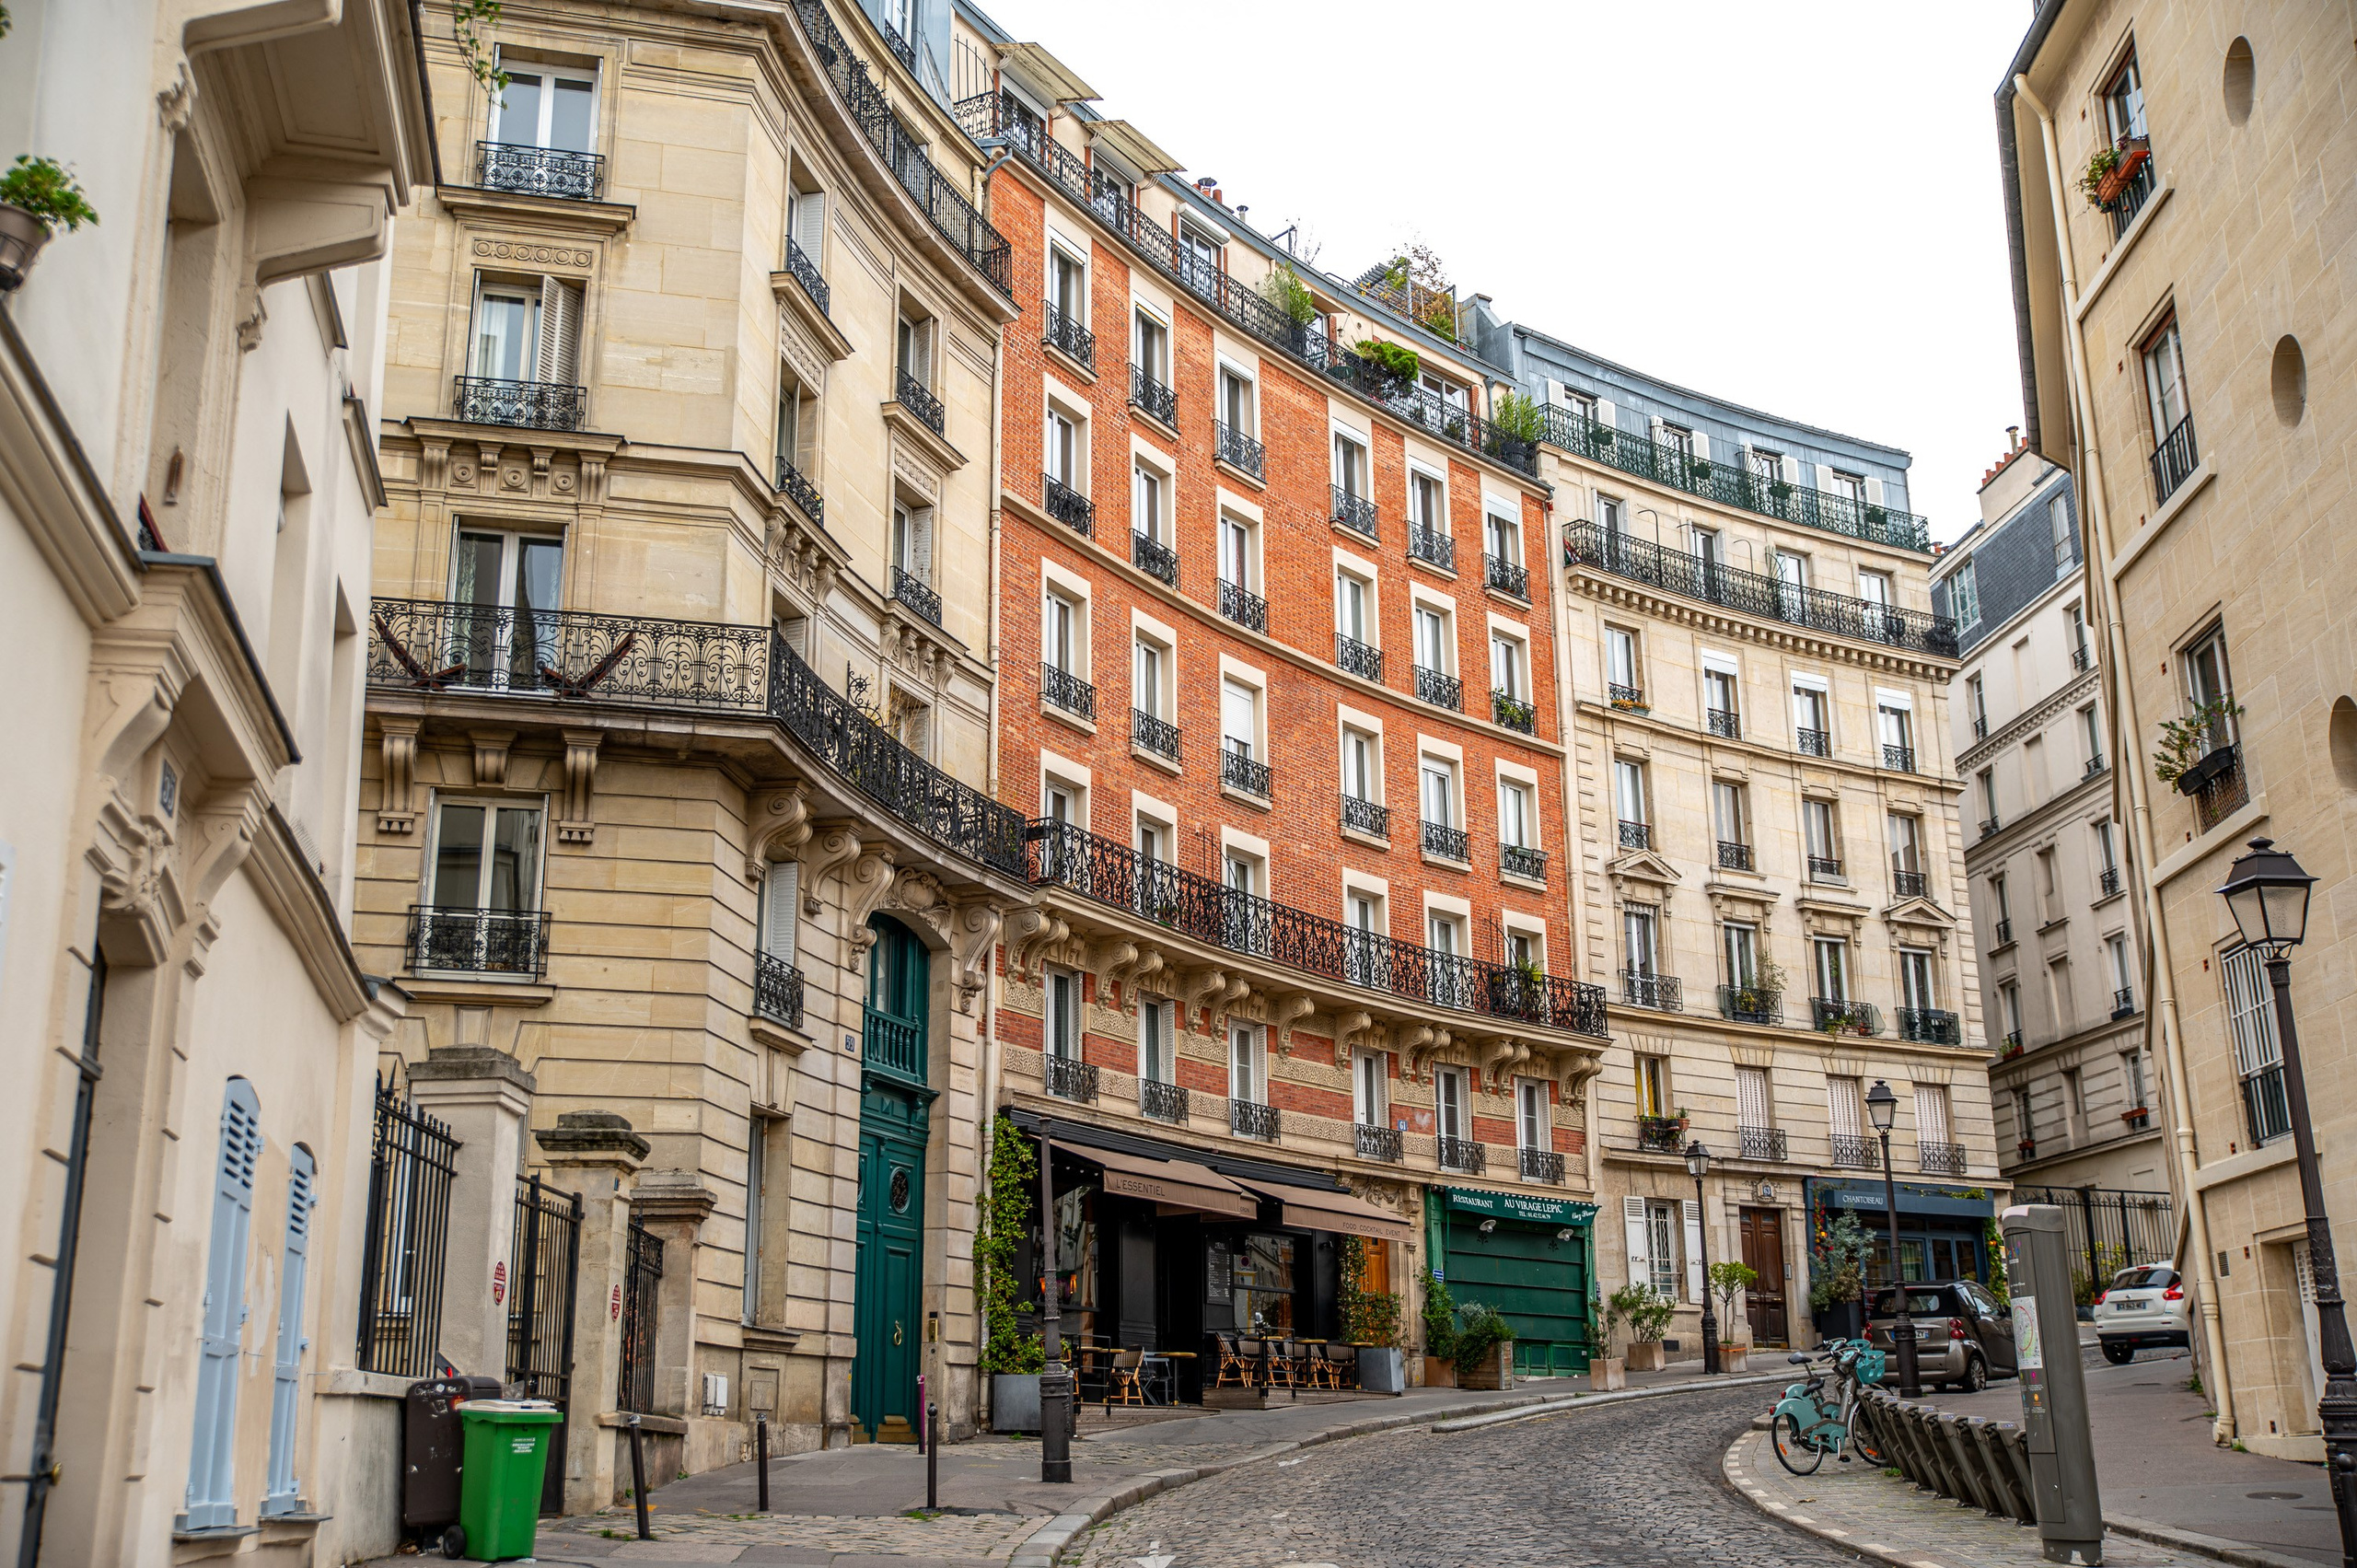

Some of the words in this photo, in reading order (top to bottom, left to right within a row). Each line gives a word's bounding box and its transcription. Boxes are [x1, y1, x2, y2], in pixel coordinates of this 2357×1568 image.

[846, 1035, 854, 1051] 59
[1399, 1121, 1406, 1131] 61
[1116, 1179, 1166, 1197] L'ESSENTIEL
[1763, 1186, 1771, 1195] 63
[1452, 1193, 1493, 1209] RESTAURANT
[1504, 1198, 1515, 1209] AU
[1515, 1199, 1543, 1213] VIRAGE
[1542, 1202, 1563, 1214] LEPIC
[1842, 1194, 1884, 1205] CHANTOISEAU
[1342, 1222, 1357, 1230] FOOD
[1359, 1225, 1383, 1235] COCKTAIL
[1385, 1228, 1400, 1237] EVENT
